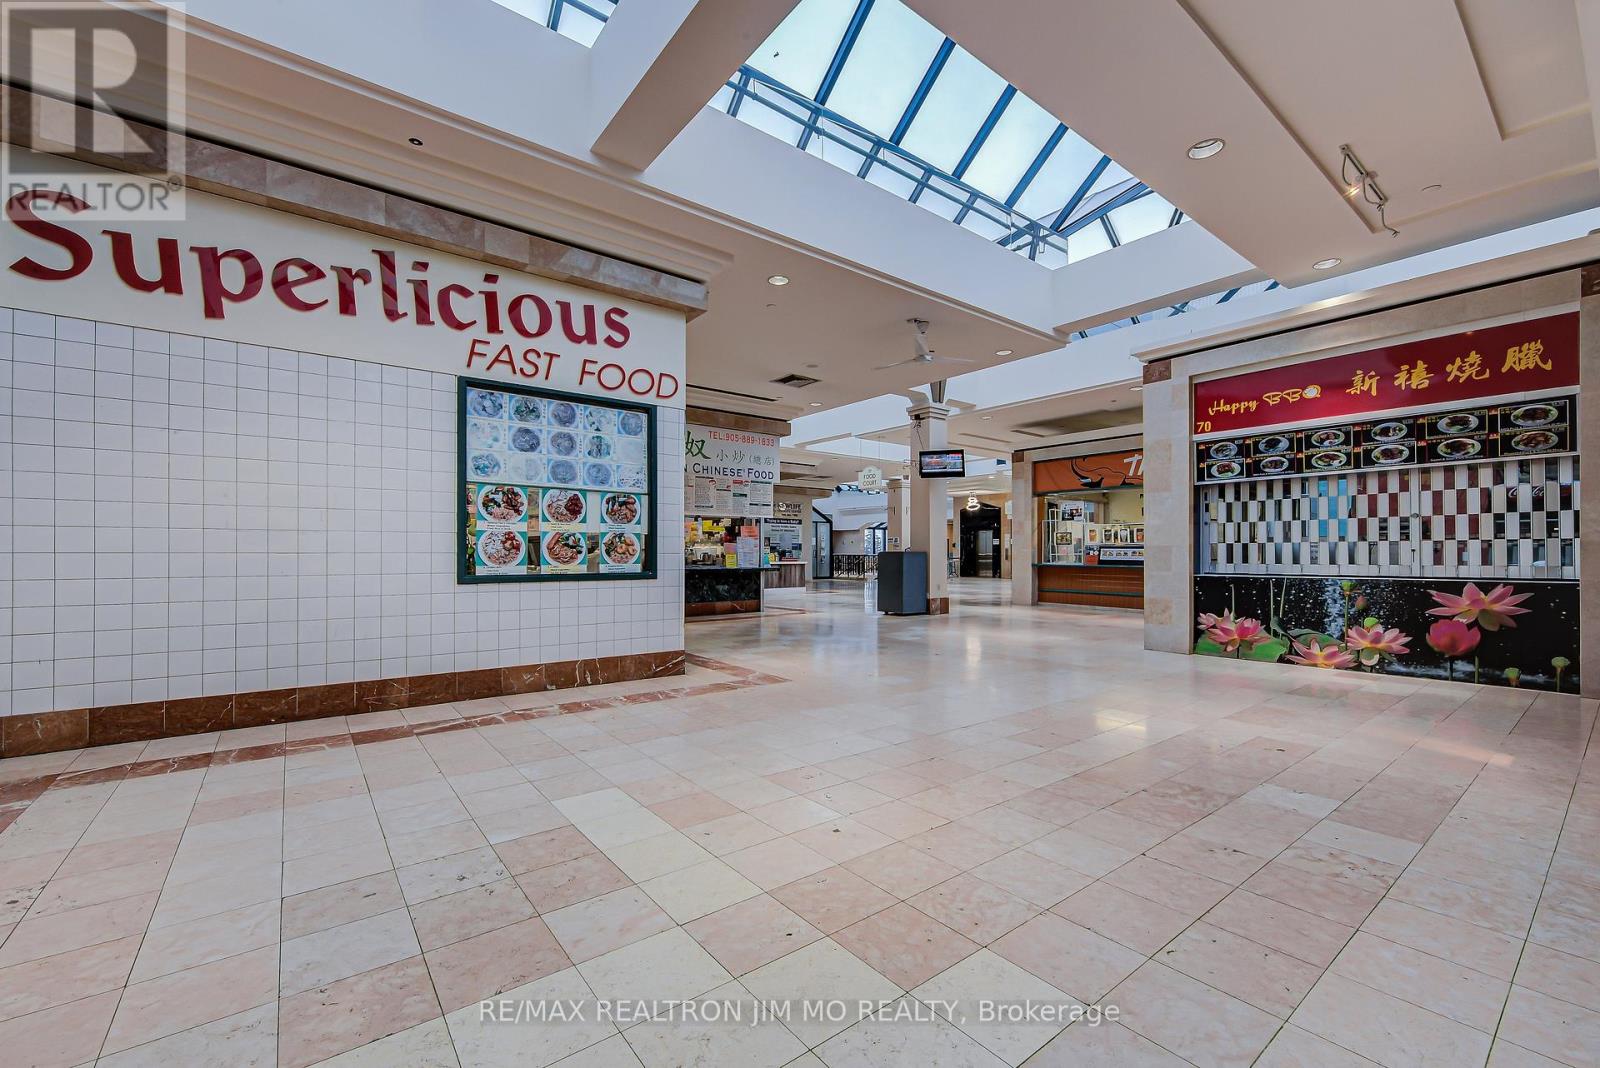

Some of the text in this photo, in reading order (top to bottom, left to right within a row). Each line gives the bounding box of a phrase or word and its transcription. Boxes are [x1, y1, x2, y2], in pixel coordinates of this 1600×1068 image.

[5, 189, 631, 349] Superlicious
[466, 338, 679, 399] FAST FOOD
[1208, 384, 1322, 416] Happy BBQ
[1196, 421, 1212, 433] 70
[692, 462, 743, 477] CHINESE
[747, 467, 774, 480] FOOD
